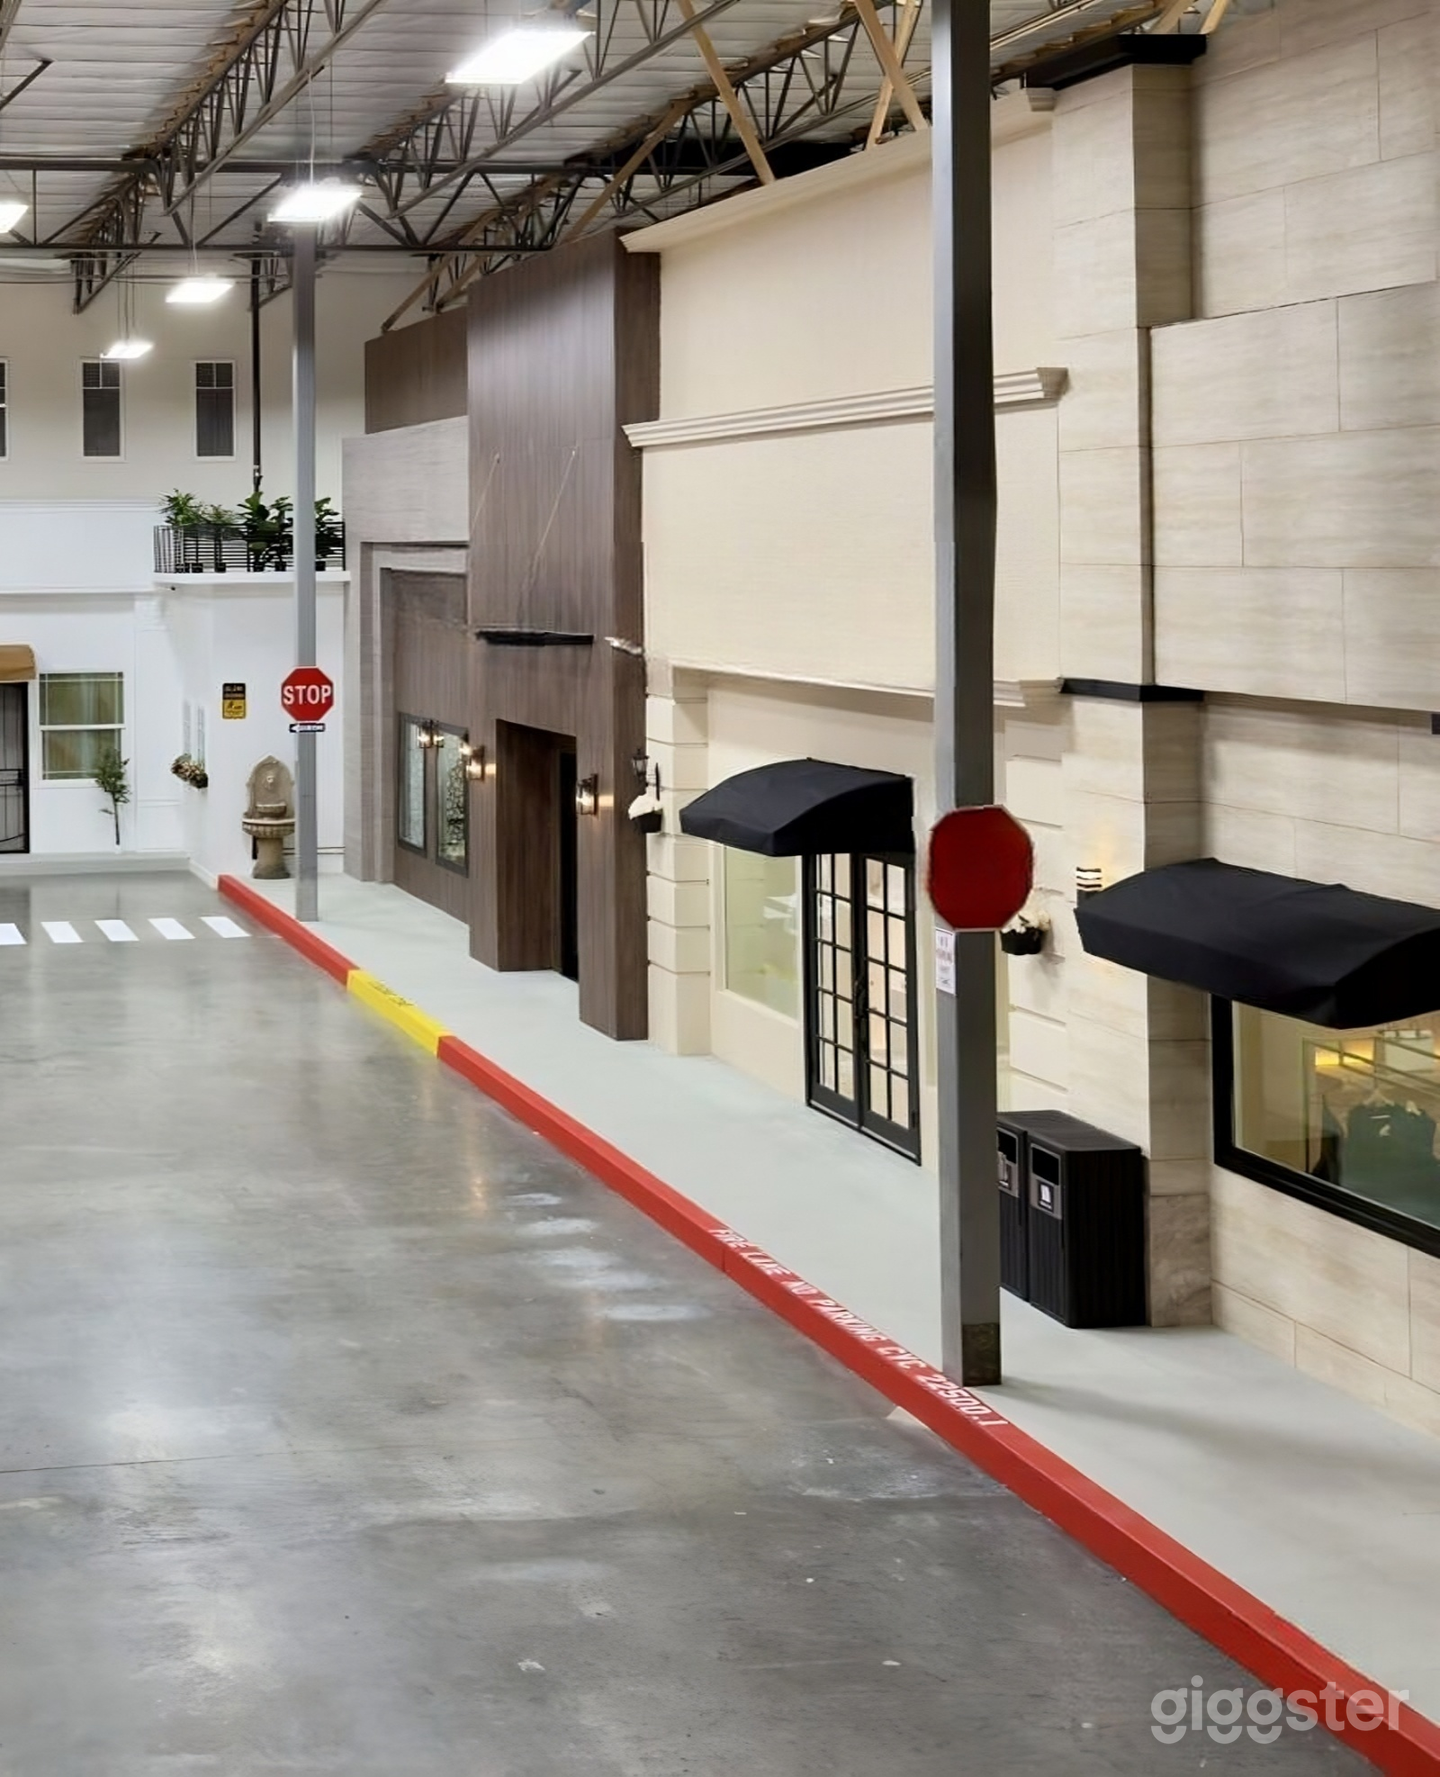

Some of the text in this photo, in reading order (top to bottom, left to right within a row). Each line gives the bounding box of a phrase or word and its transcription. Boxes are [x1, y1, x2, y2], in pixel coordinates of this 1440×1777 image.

[282, 684, 332, 705] STOP
[780, 1281, 818, 1296] NO
[806, 1299, 888, 1341] PARKING
[917, 1374, 1009, 1426] 22500.1
